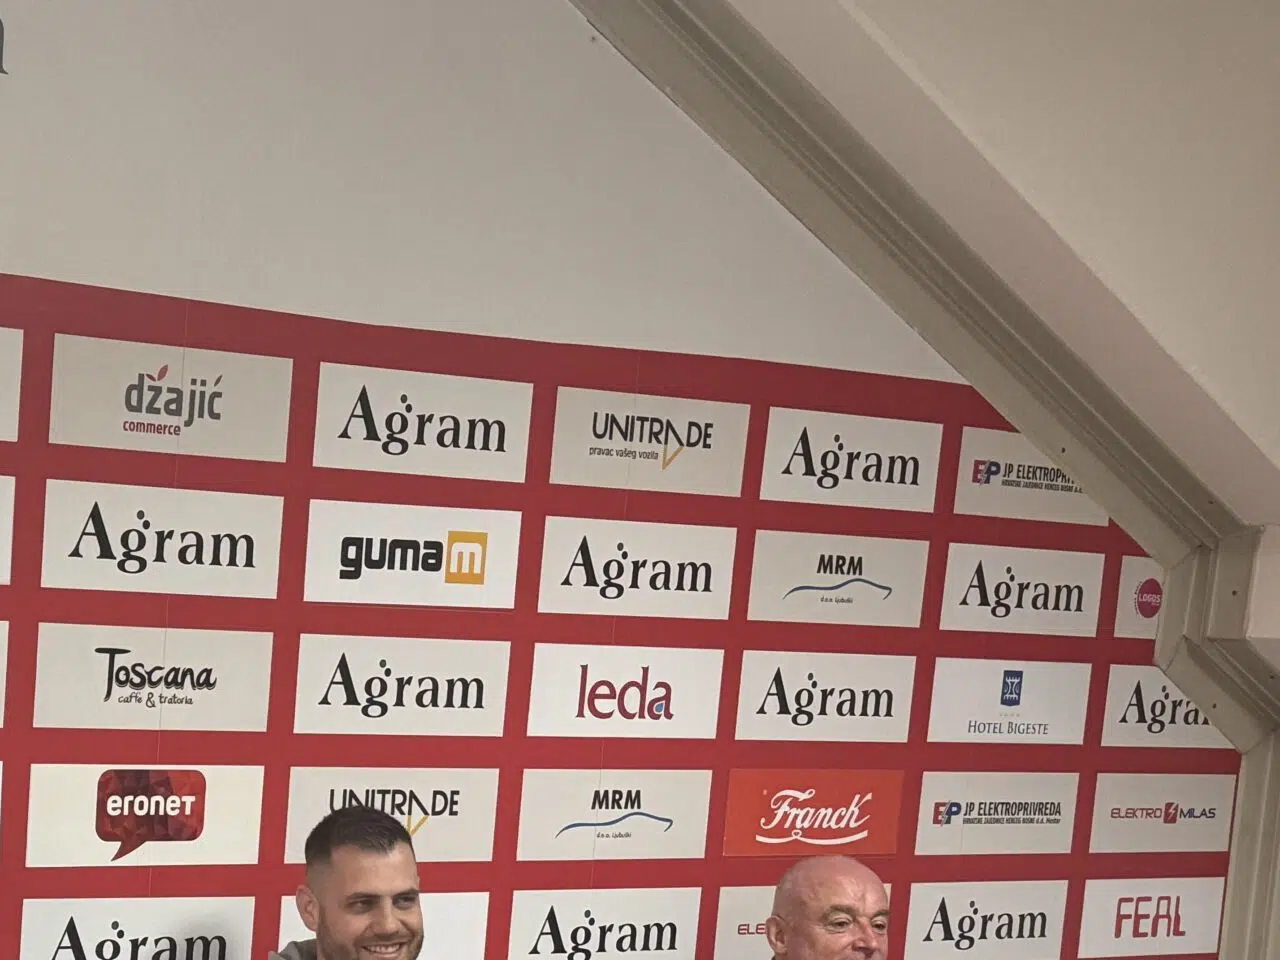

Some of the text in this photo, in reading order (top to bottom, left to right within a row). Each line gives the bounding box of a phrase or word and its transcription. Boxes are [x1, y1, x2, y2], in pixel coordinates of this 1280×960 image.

[125, 364, 223, 428] džajić
[123, 420, 181, 436] commerce
[337, 384, 507, 455] Agram
[592, 411, 714, 450] UNITRADE
[589, 446, 659, 460] pravac vašeg vozila
[781, 426, 920, 489] Agram
[1002, 463, 1014, 478] JP
[68, 501, 256, 574] Agram
[560, 535, 714, 599] Agram
[816, 554, 863, 576] MRM
[959, 560, 1084, 618] Agram
[94, 647, 217, 702] Toscana
[318, 651, 485, 718] Agram
[576, 664, 674, 721] leda
[145, 692, 156, 708] &
[756, 666, 894, 726] Agram
[967, 720, 1049, 735] HOTEL BIGESTE
[106, 792, 196, 816] eronet
[591, 789, 641, 809] MRM
[760, 788, 872, 829] Franck
[963, 802, 1061, 816] JP ELEKTROPRIVREDA
[1111, 808, 1216, 819] ELEKTRO MILAS
[923, 897, 1048, 951] Agram
[1114, 895, 1187, 938] FEAL
